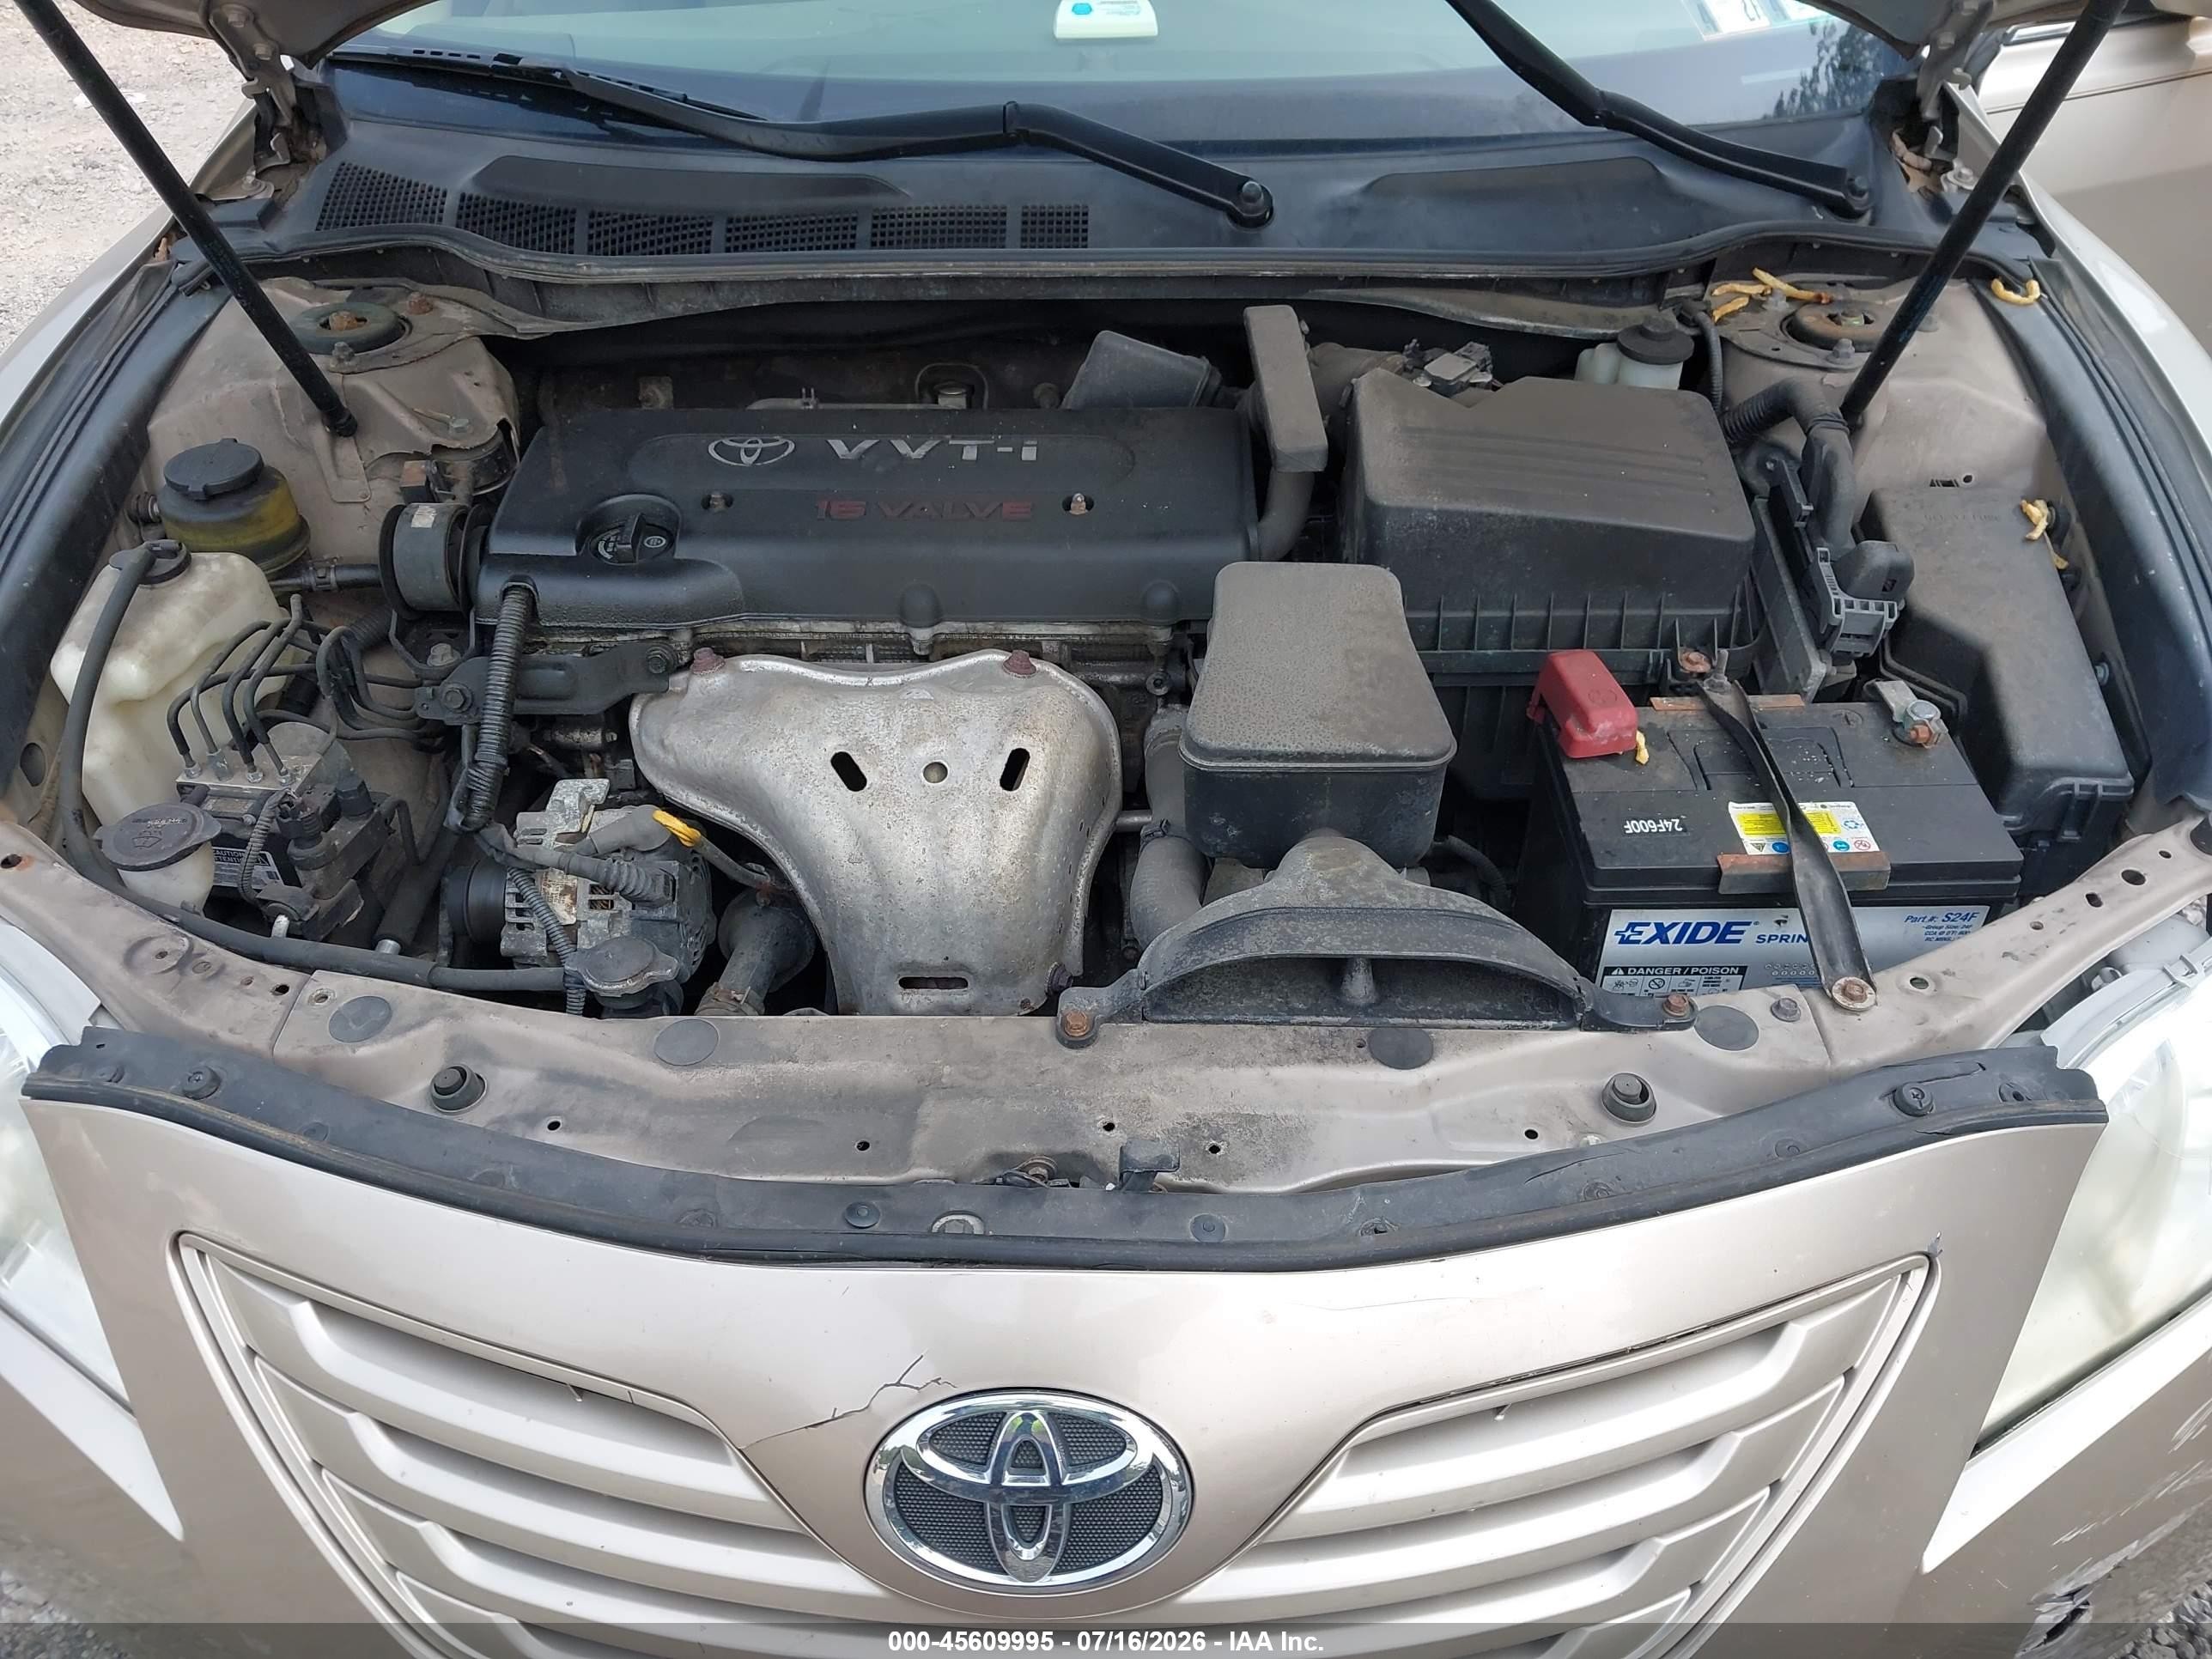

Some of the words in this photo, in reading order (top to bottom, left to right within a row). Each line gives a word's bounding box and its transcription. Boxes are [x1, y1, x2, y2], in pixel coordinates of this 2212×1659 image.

[826, 439, 1037, 461] VVT-i
[817, 501, 866, 521] 16
[878, 501, 1033, 521] VALVE
[1624, 818, 1683, 834] 24F600F
[1942, 912, 1980, 923] S24F
